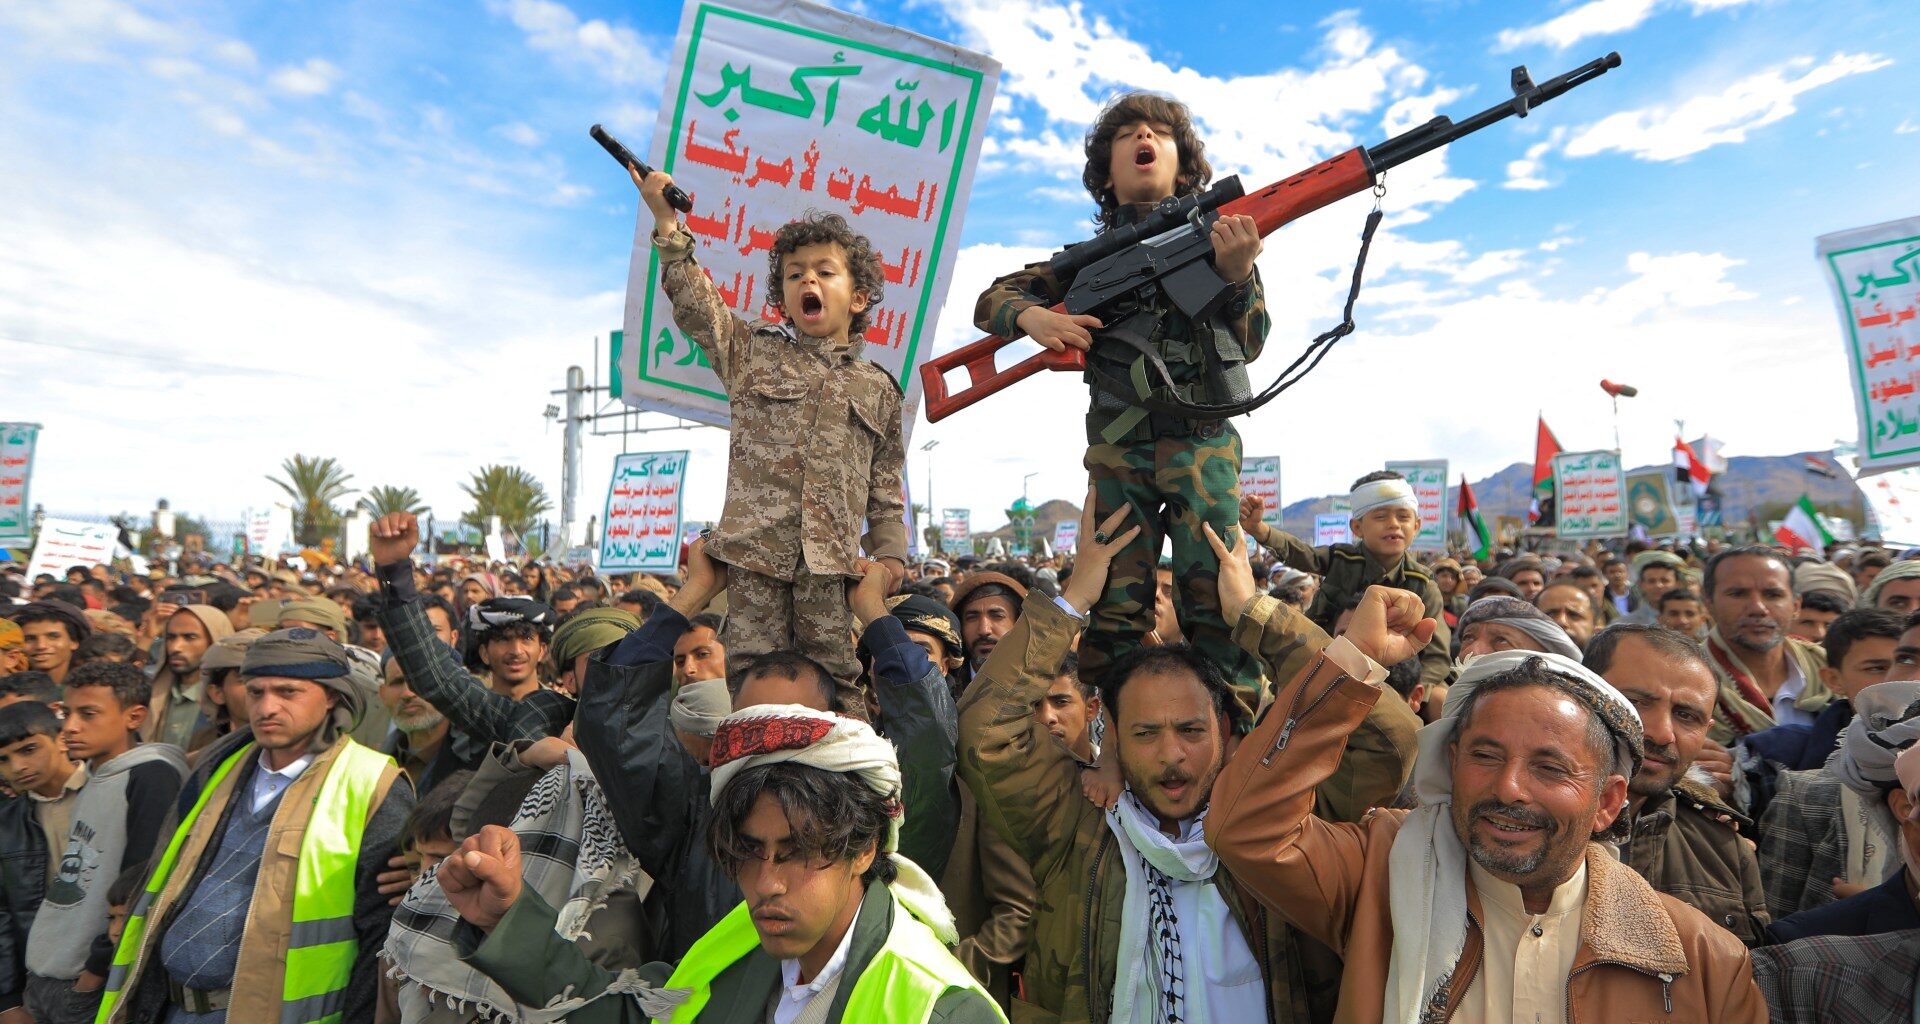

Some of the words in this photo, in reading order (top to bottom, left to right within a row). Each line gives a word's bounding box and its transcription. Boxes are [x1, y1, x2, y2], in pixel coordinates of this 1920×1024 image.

[693, 51, 863, 128] أكبر
[856, 78, 958, 154] الله
[683, 119, 820, 191] لأمريكا
[826, 165, 938, 223] الموت
[616, 456, 658, 482] أكبر
[657, 457, 682, 476] الله
[652, 482, 678, 498] الموت
[650, 502, 677, 519] الموت
[607, 522, 634, 539] اليهود
[636, 523, 650, 539] على
[653, 522, 676, 536] اللعنة
[641, 539, 673, 562] النصر
